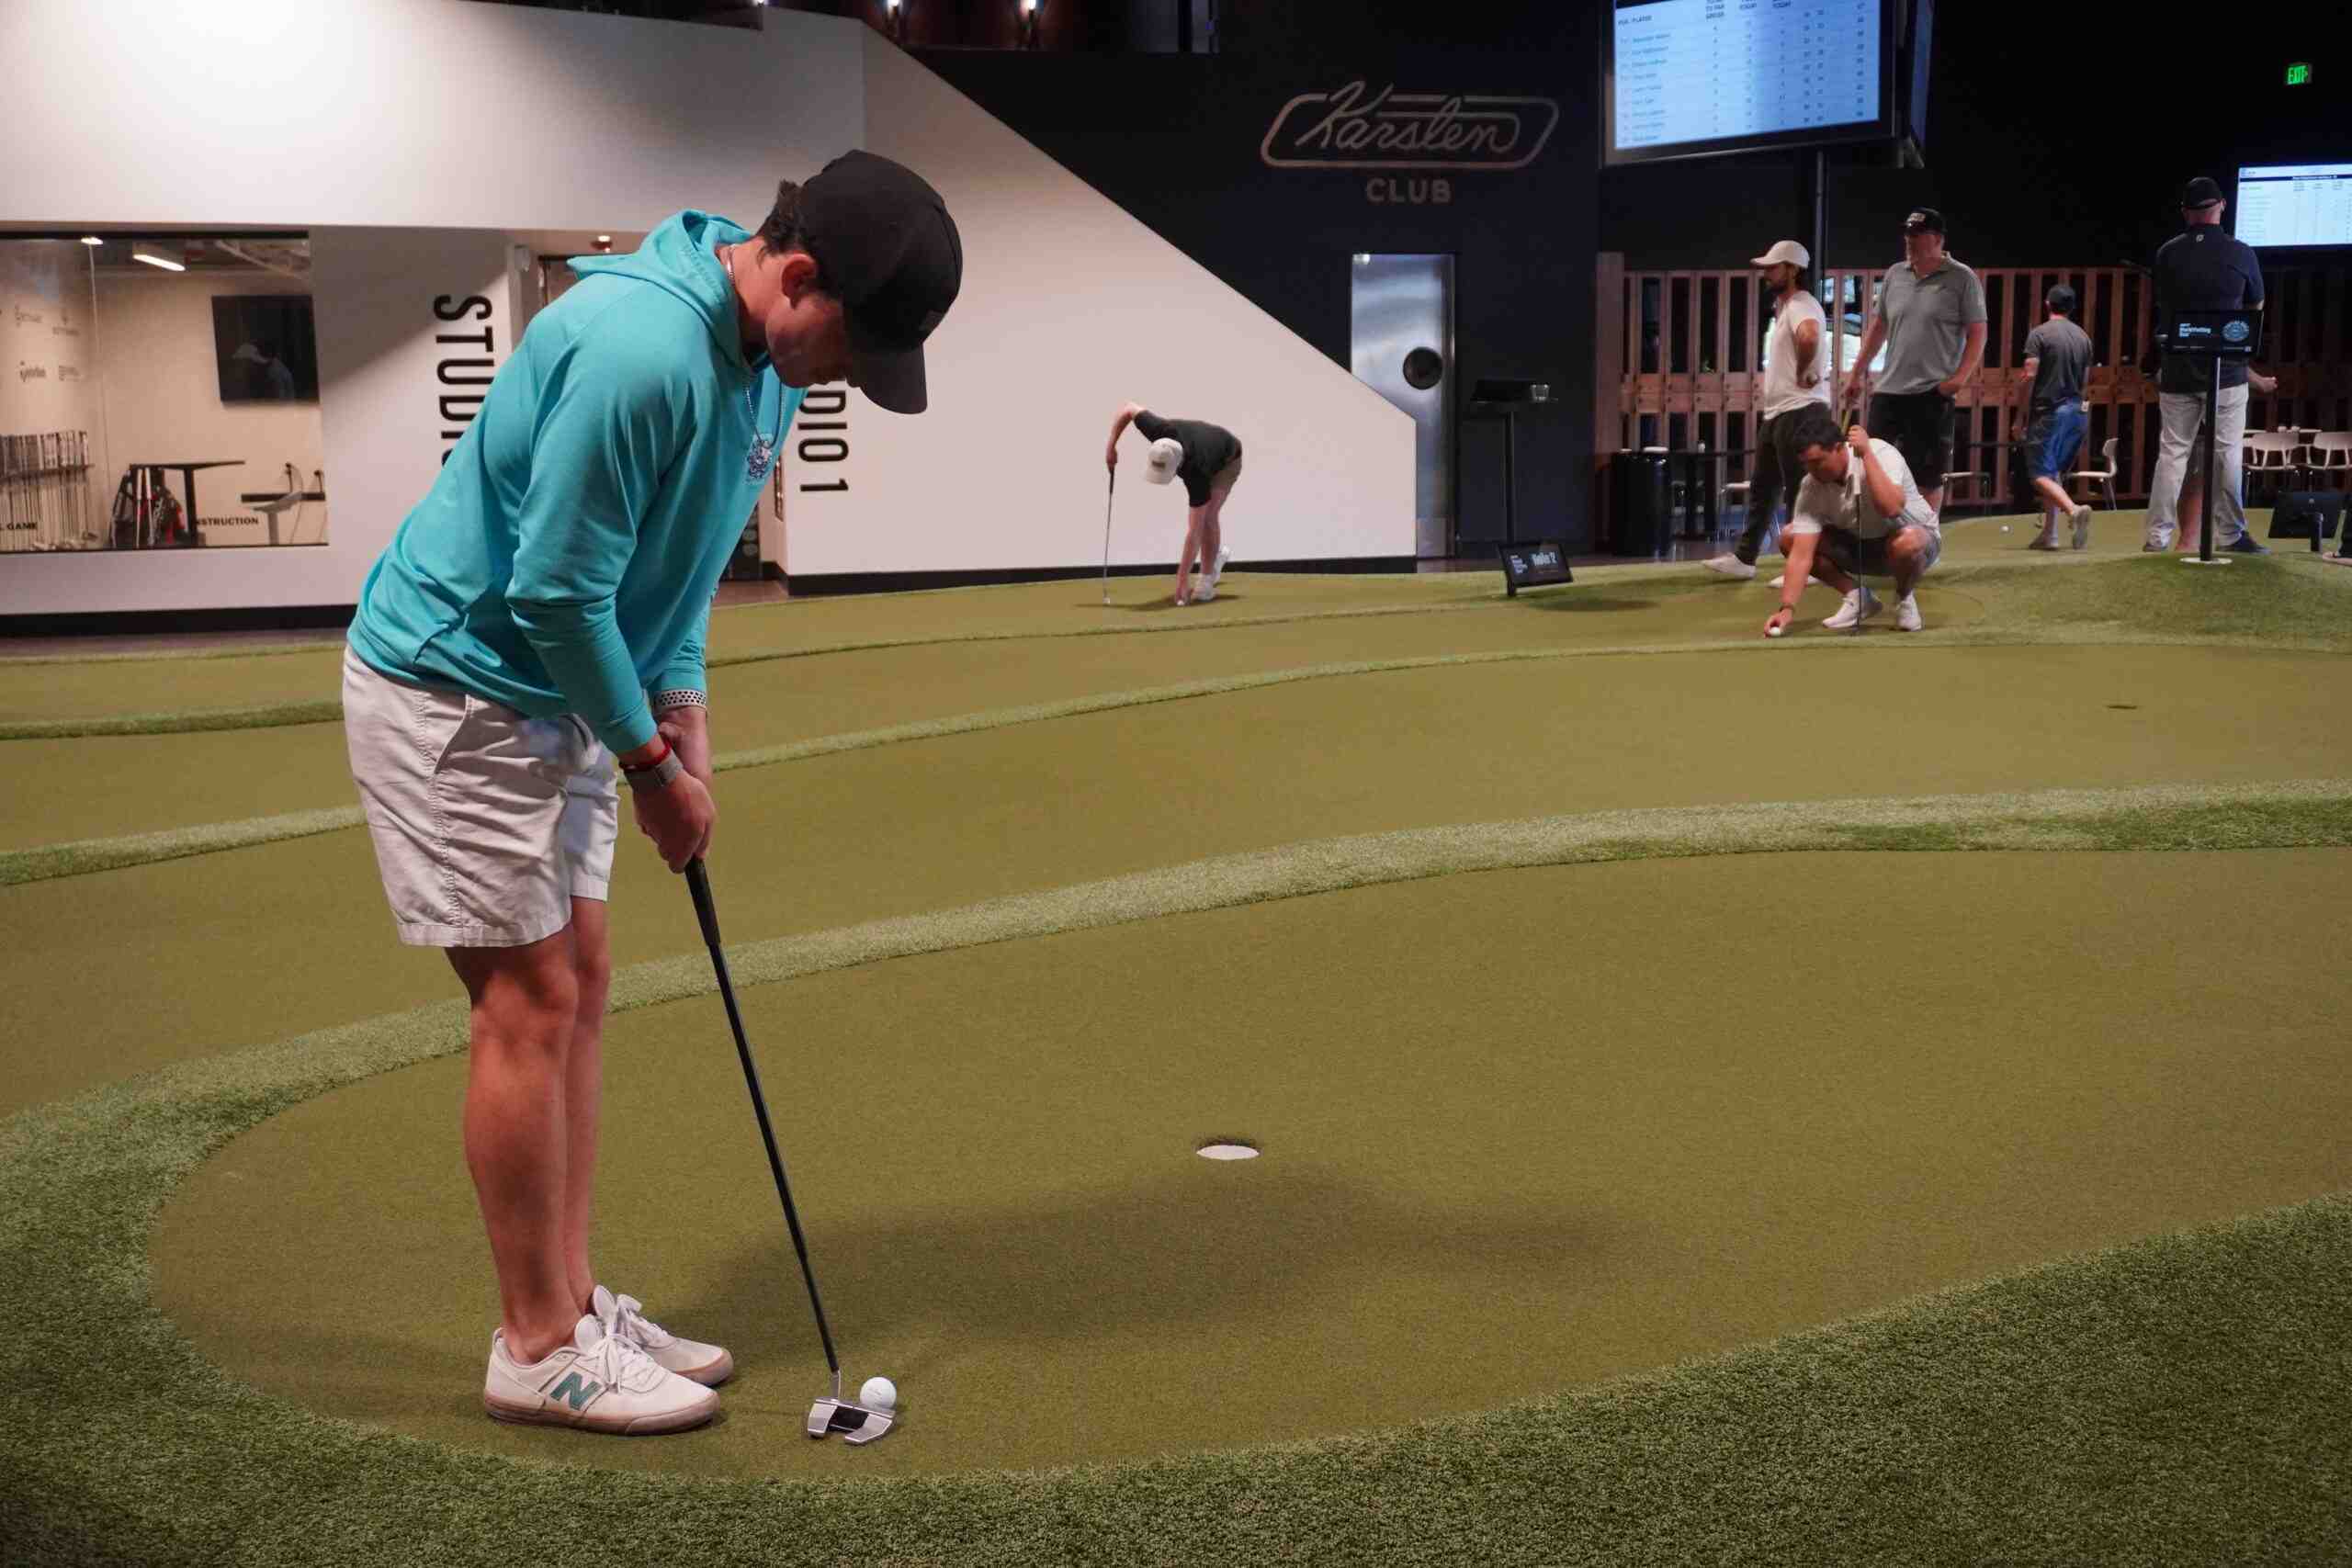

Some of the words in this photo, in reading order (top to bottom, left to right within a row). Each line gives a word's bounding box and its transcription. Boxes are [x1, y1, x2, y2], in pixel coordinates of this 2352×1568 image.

[2287, 65, 2306, 85] EXIT
[1295, 80, 1521, 153] Karsten
[1365, 178, 1453, 204] CLUB
[800, 478, 849, 492] 1
[549, 1371, 603, 1411] N
